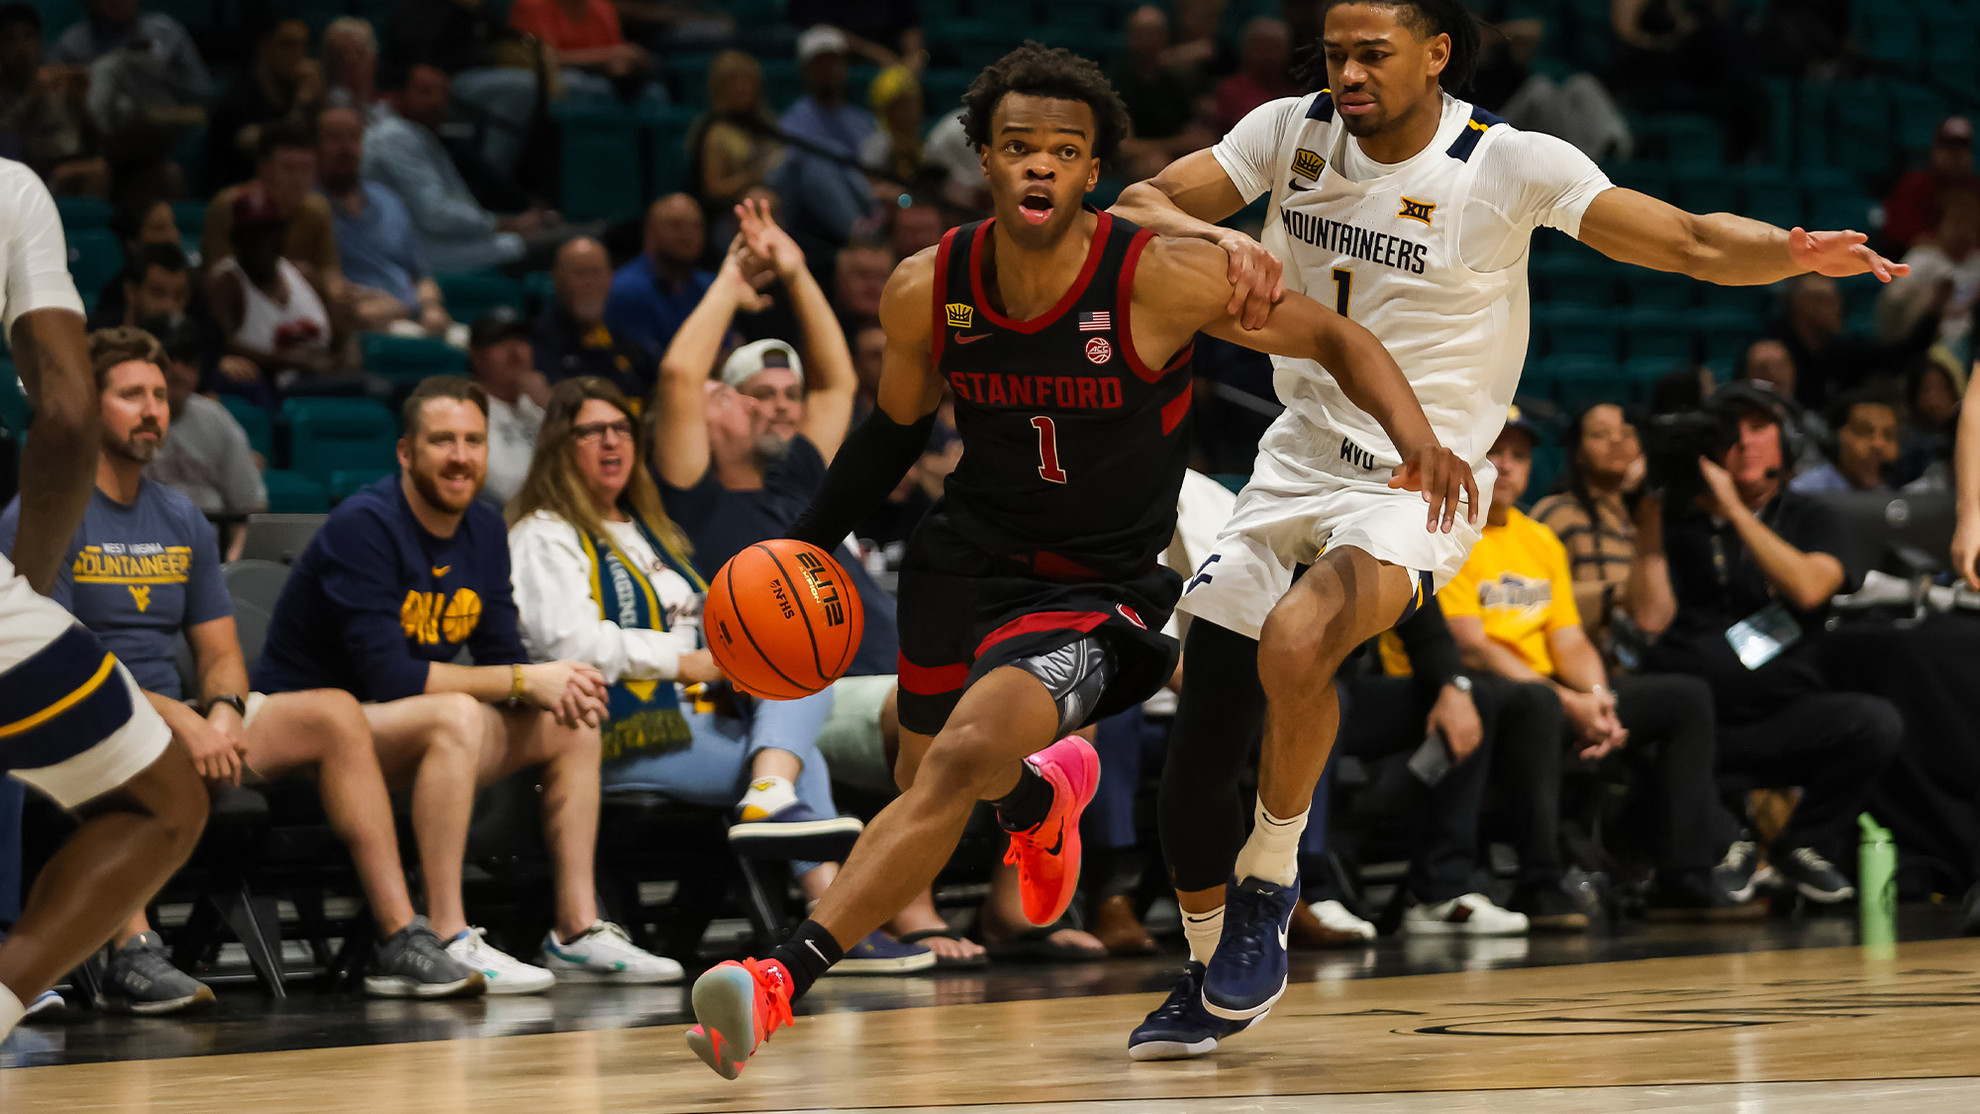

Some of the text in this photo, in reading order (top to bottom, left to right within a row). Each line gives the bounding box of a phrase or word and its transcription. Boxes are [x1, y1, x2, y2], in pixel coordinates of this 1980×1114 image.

[1280, 205, 1427, 275] MOUNTAINEERS
[1331, 267, 1354, 318] 1
[950, 371, 1123, 409] STANFORD
[1030, 415, 1067, 484] 1
[1340, 436, 1375, 470] WVU
[773, 587, 795, 620] NFHS
[795, 552, 844, 627] ELITE
